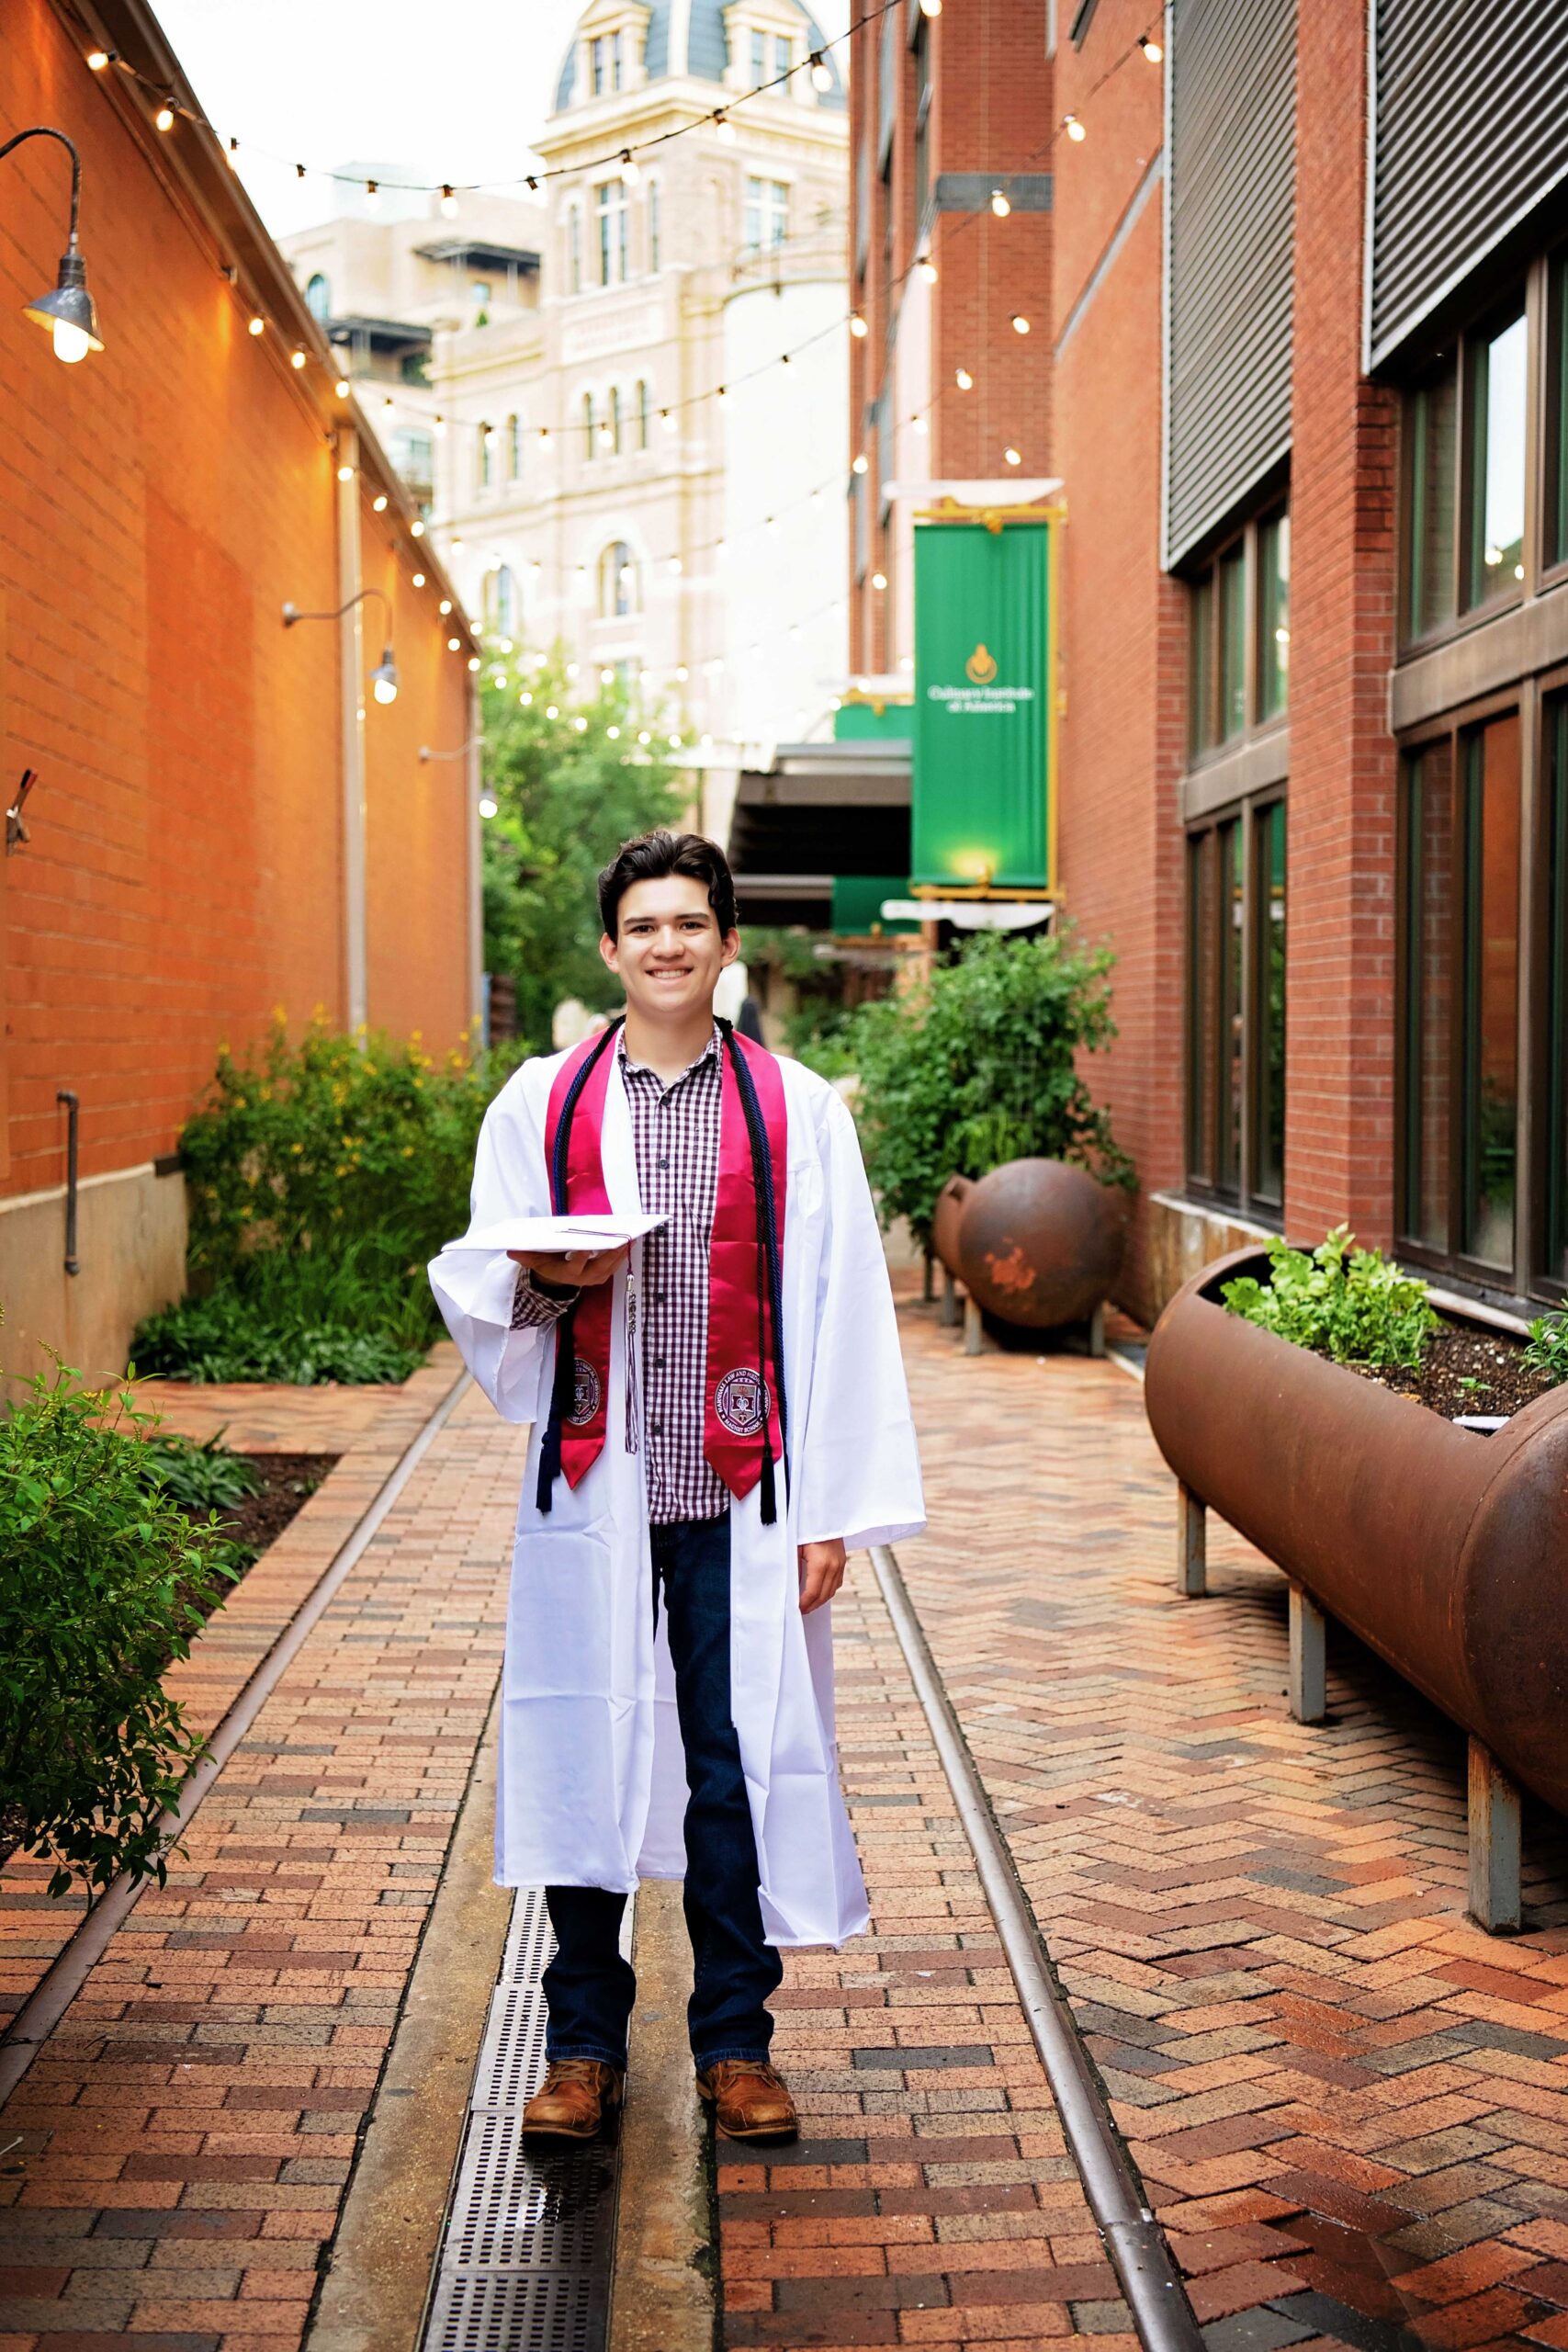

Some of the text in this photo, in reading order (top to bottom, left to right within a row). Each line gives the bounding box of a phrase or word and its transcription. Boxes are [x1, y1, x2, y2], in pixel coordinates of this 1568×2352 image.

[716, 1383, 726, 1412] MARSHALL
[725, 1374, 736, 1385] LAW
[735, 1370, 747, 1378] AND
[724, 1419, 761, 1432] MAGNET SCHOOL
